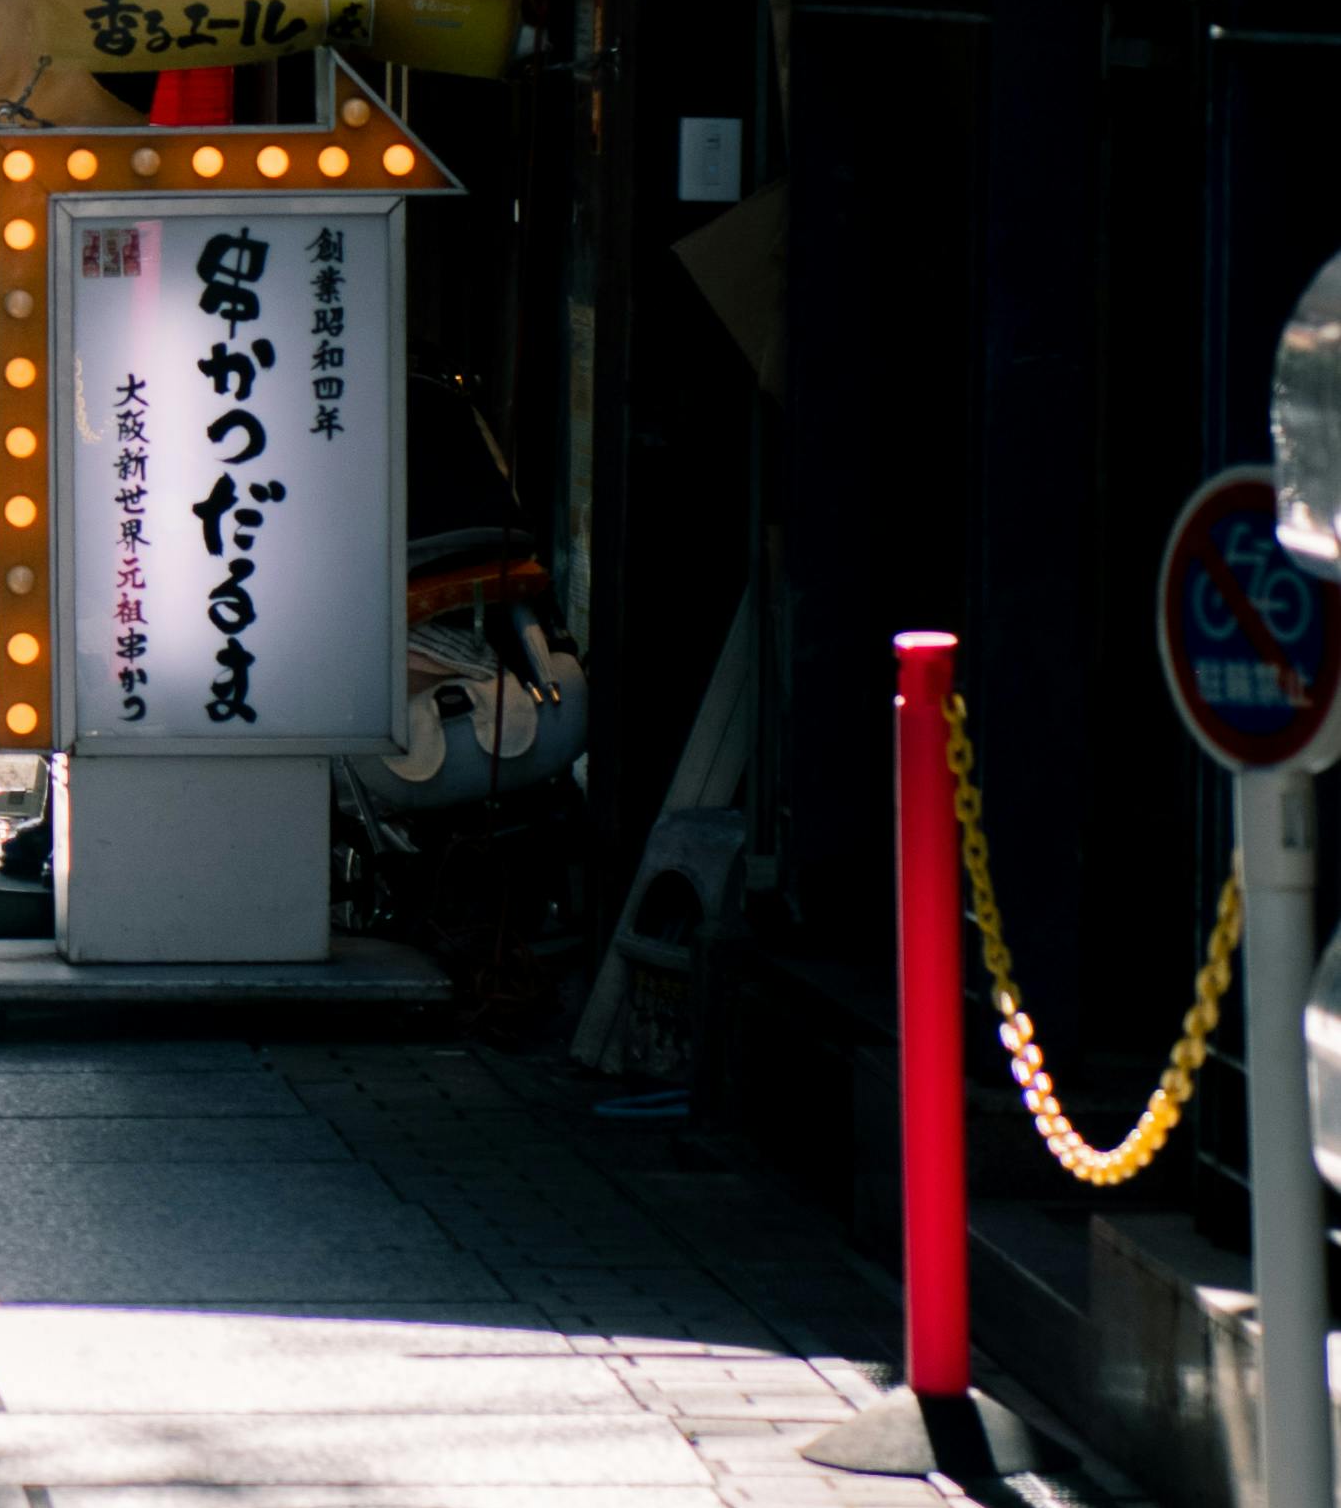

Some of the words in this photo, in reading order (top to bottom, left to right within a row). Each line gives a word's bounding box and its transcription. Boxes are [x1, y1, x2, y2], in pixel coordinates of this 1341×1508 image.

[192, 226, 287, 725] 串かつだるま
[305, 226, 346, 441] 創業昭和四年
[114, 372, 150, 722] 大阪新世界元祖串かつ
